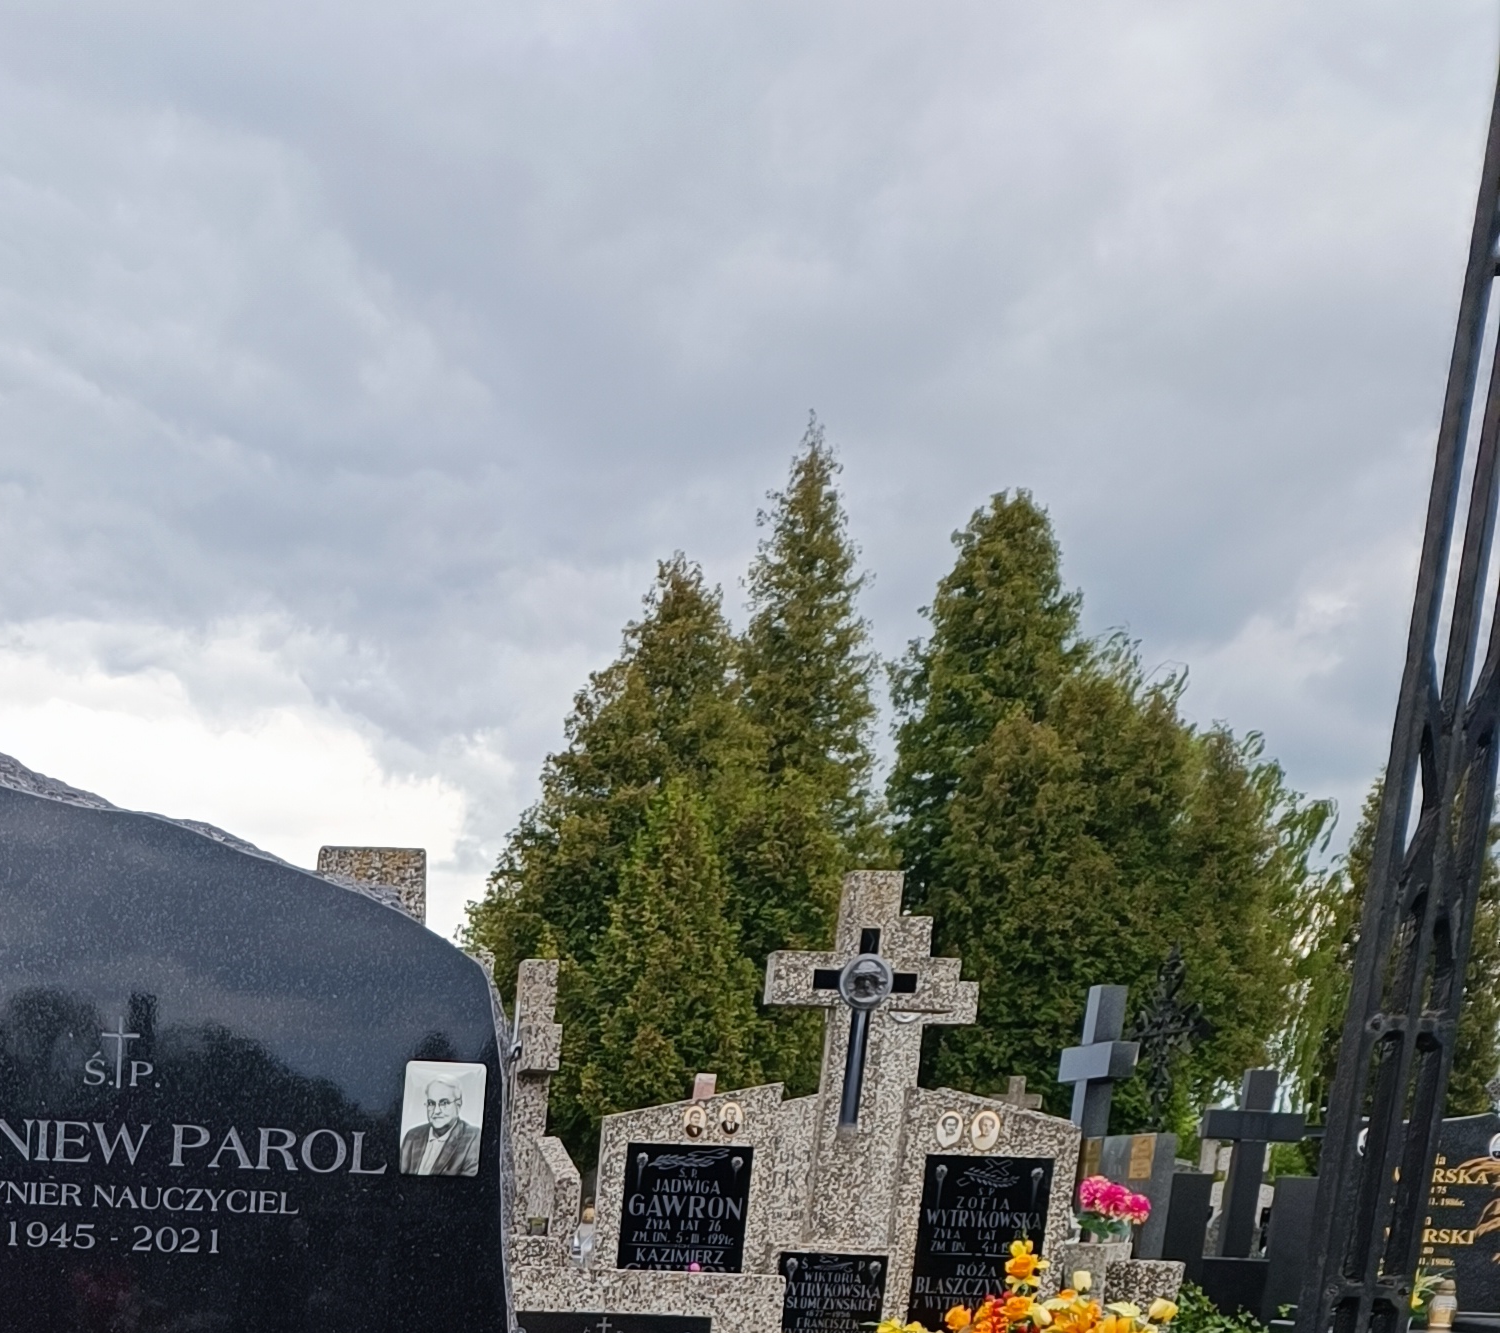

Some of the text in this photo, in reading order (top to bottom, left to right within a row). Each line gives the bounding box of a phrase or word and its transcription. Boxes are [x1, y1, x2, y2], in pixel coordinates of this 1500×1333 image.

[83, 1051, 161, 1088] Ś. P.
[169, 1123, 388, 1175] PAROL
[1432, 1168, 1489, 1185] RSKA
[652, 1179, 721, 1195] JADWIGA
[92, 1184, 299, 1215] NAUCZYCIEL
[628, 1193, 743, 1221] GAWRON
[956, 1196, 1010, 1211] ZOFIA
[681, 1219, 701, 1231] LAT
[708, 1220, 722, 1232] 76
[926, 1209, 1042, 1230] WYTRYKOWSKA
[8, 1221, 96, 1249] 1945
[132, 1225, 220, 1254] 2021
[978, 1229, 997, 1241] LAT
[1422, 1229, 1476, 1245] RSKI
[636, 1247, 725, 1265] KAZIMIERZ
[804, 1271, 861, 1284] WIKTORIA
[956, 1261, 997, 1277] RÓŻA
